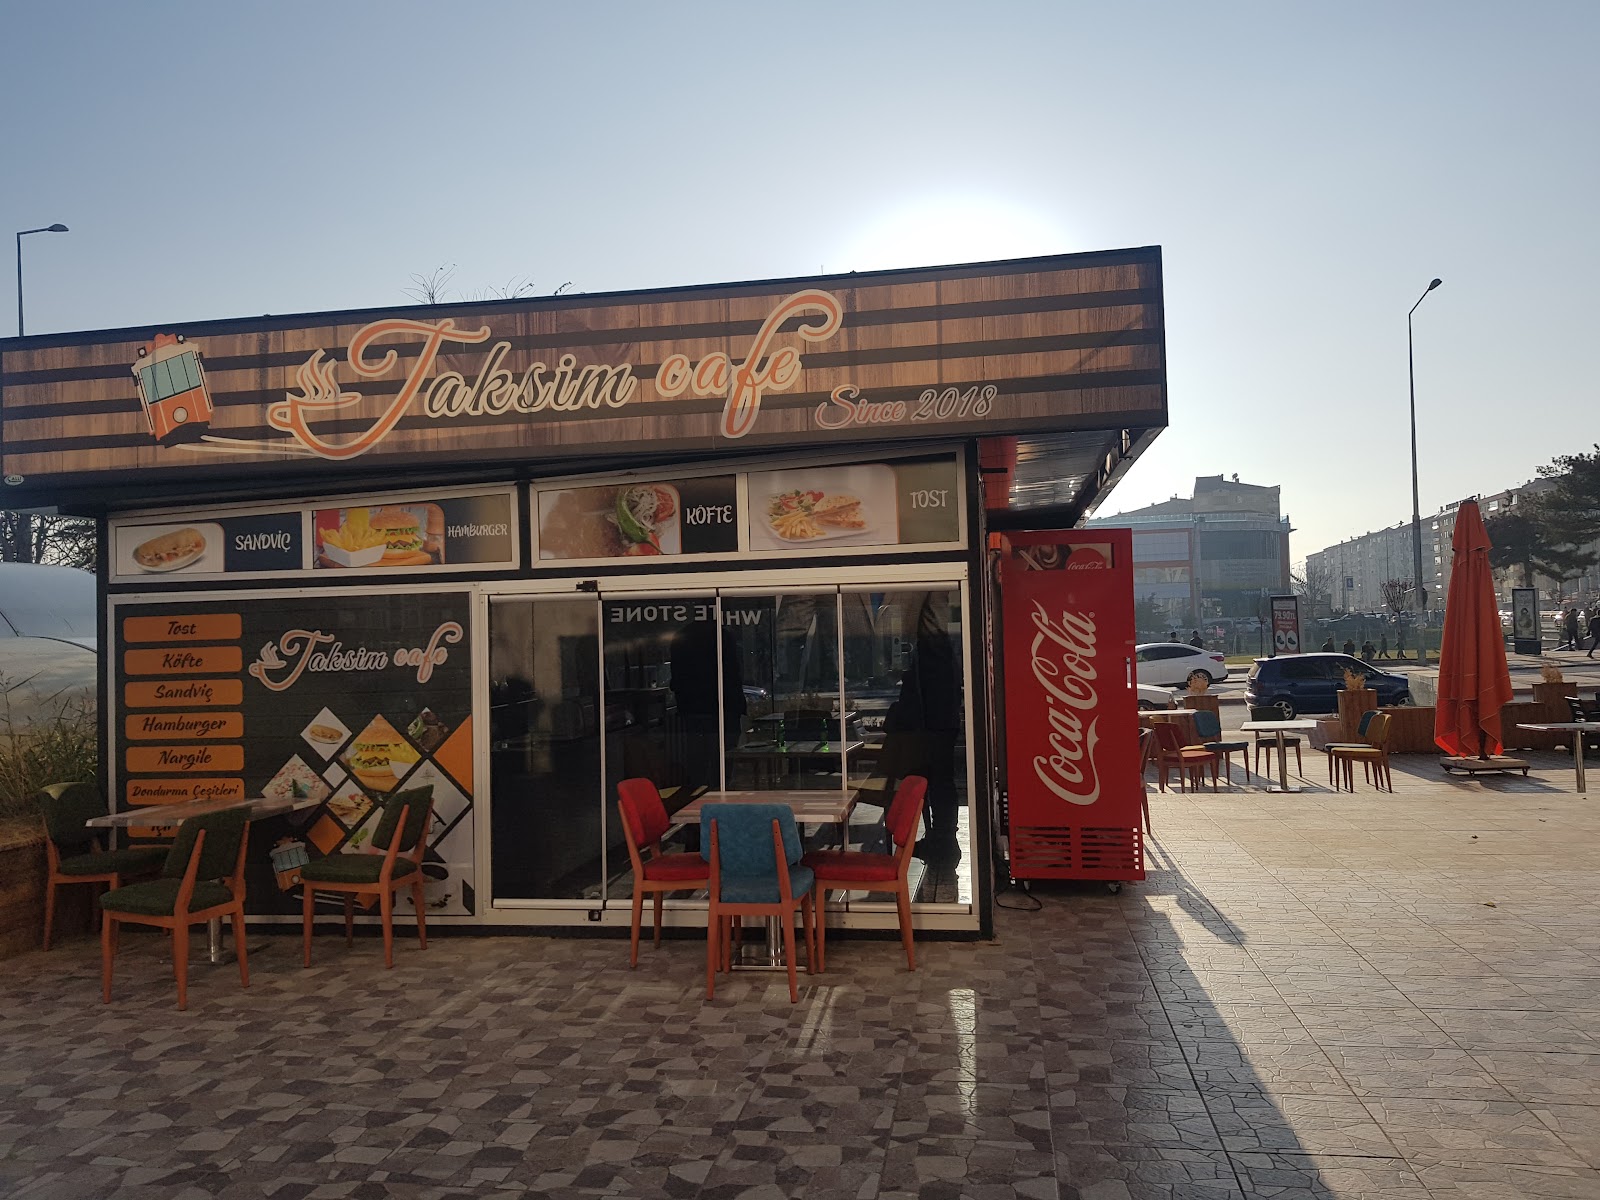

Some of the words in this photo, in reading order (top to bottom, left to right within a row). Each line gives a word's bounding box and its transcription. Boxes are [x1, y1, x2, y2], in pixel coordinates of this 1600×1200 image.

[290, 318, 638, 461] Taksim
[655, 288, 844, 440] cafe
[814, 383, 907, 430] Since
[910, 384, 998, 421] 2018
[909, 489, 949, 509] TOST
[686, 504, 733, 525] KÖFTE
[447, 523, 508, 539] HAMBURGER
[167, 621, 197, 635] Tost
[162, 652, 203, 669] Köfte
[256, 629, 389, 692] Taksim
[393, 621, 464, 684] cafe
[154, 683, 213, 702] Sandviç
[142, 715, 227, 737] Hamburger
[158, 747, 212, 770] Nargile
[132, 785, 188, 797] Dondurma
[193, 783, 240, 799] Çeşitleri
